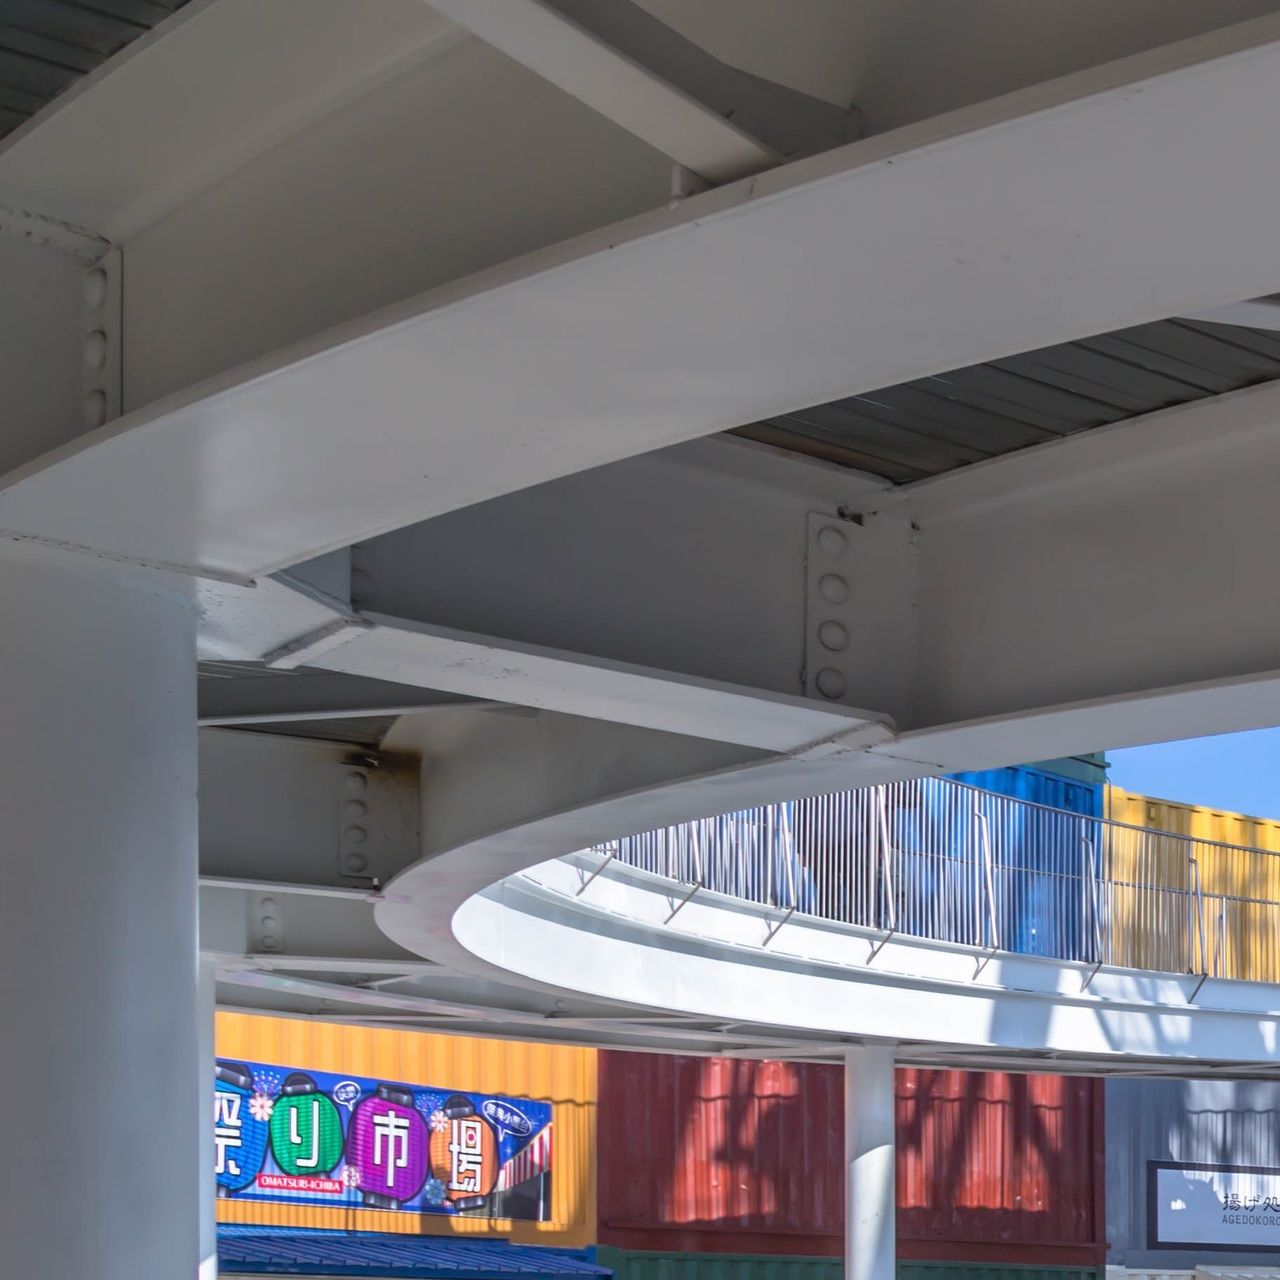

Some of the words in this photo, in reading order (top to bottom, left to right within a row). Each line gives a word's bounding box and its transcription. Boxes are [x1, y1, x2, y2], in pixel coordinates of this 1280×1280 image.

[261, 1176, 341, 1192] OMATSURI-ICHIBA
[1222, 1193, 1280, 1213] 揚げ処
